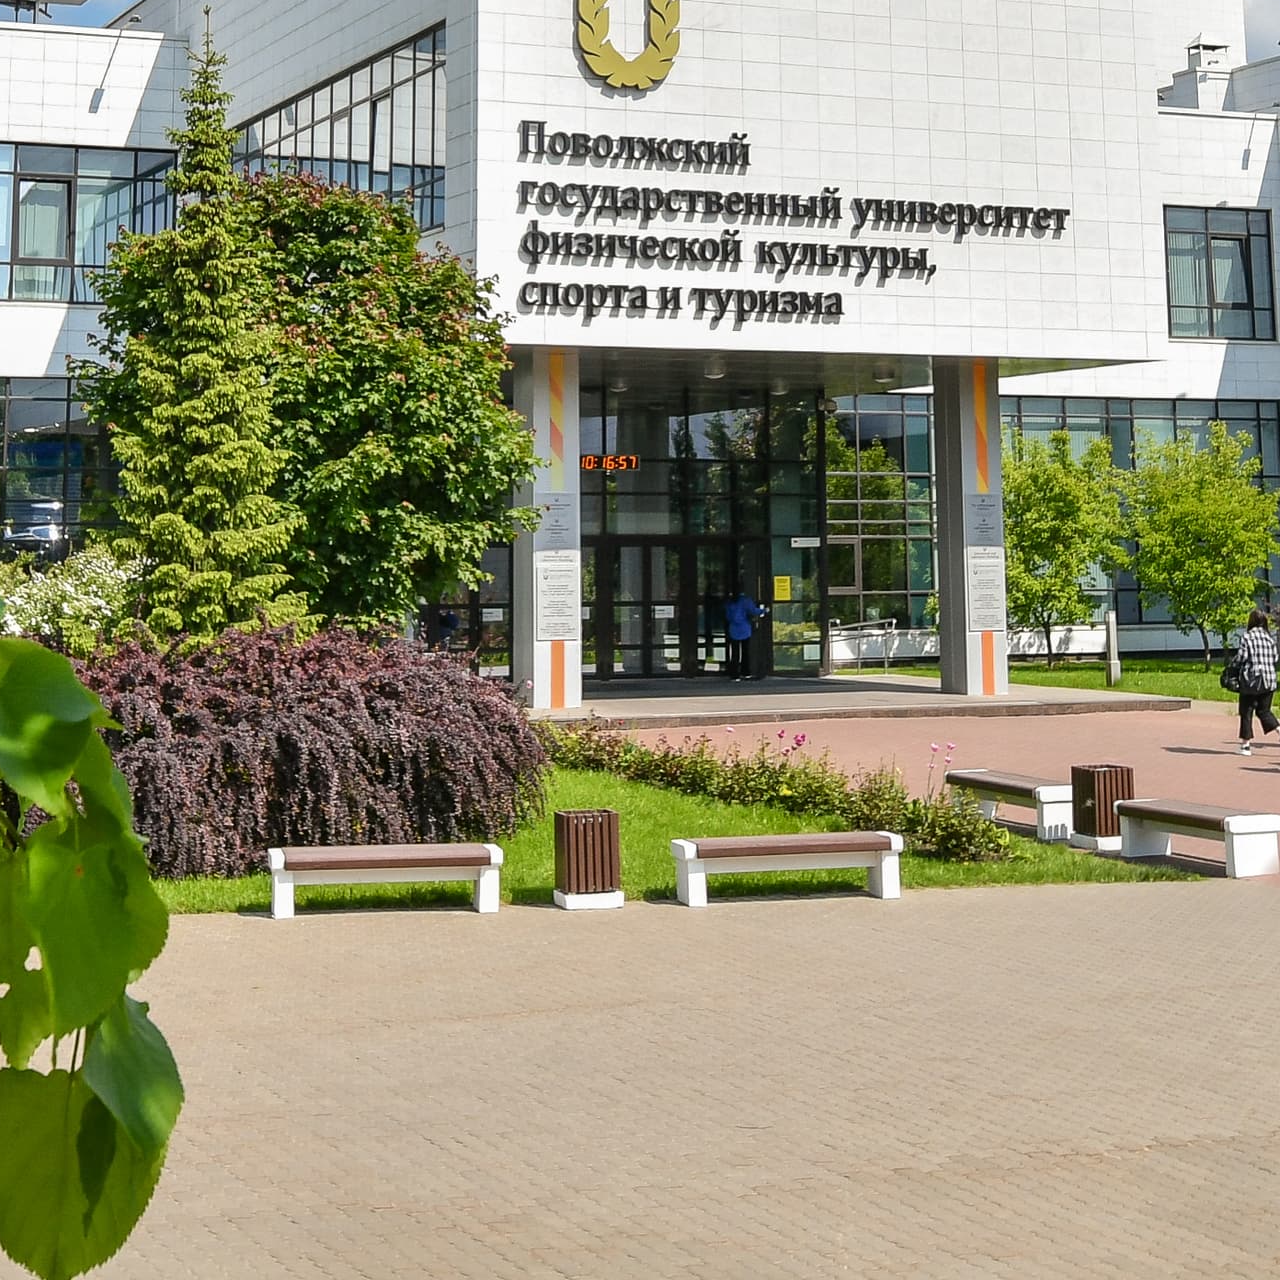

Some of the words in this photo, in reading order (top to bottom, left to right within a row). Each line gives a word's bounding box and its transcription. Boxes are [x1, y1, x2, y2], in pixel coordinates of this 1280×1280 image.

[519, 120, 751, 167] Поволжский
[519, 180, 842, 222] государственный
[852, 198, 1071, 236] университет
[519, 220, 743, 266] физической
[757, 240, 937, 280] культуры,
[519, 280, 648, 319] спорта
[659, 285, 682, 311] и
[690, 286, 845, 324] туризма
[581, 455, 637, 470] 10:16:57
